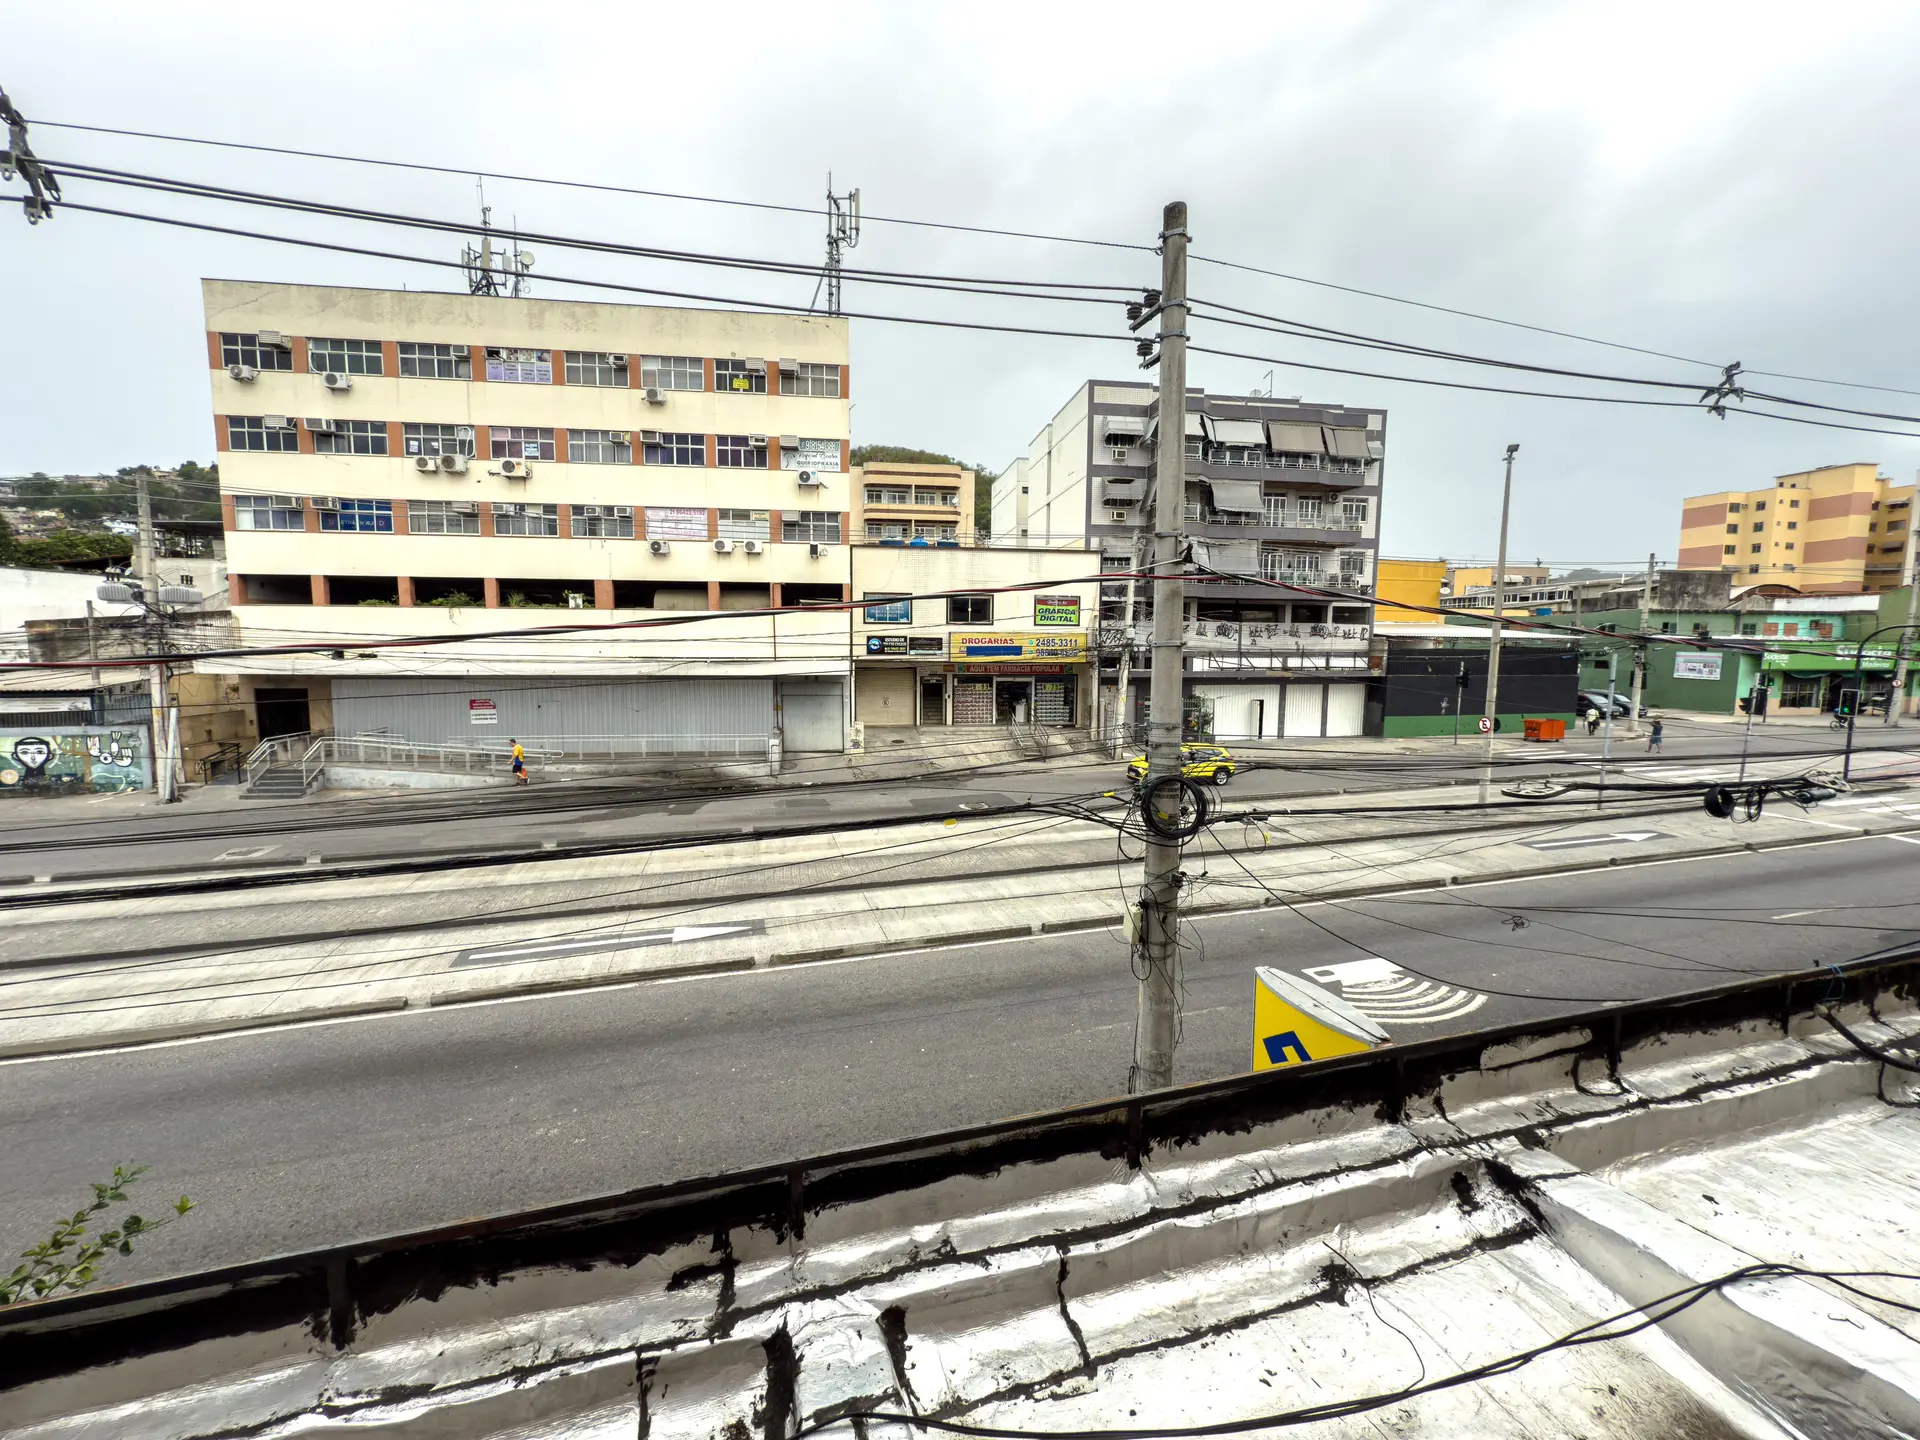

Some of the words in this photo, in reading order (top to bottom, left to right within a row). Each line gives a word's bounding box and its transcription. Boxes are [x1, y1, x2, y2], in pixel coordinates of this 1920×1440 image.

[1040, 615, 1074, 623] DIGITAL
[961, 637, 1015, 645] DROGARIAS
[1036, 638, 1079, 648] 2485-3311
[970, 665, 985, 673] AQUI
[987, 665, 1000, 673] TEM
[1032, 665, 1060, 673] POPULAR
